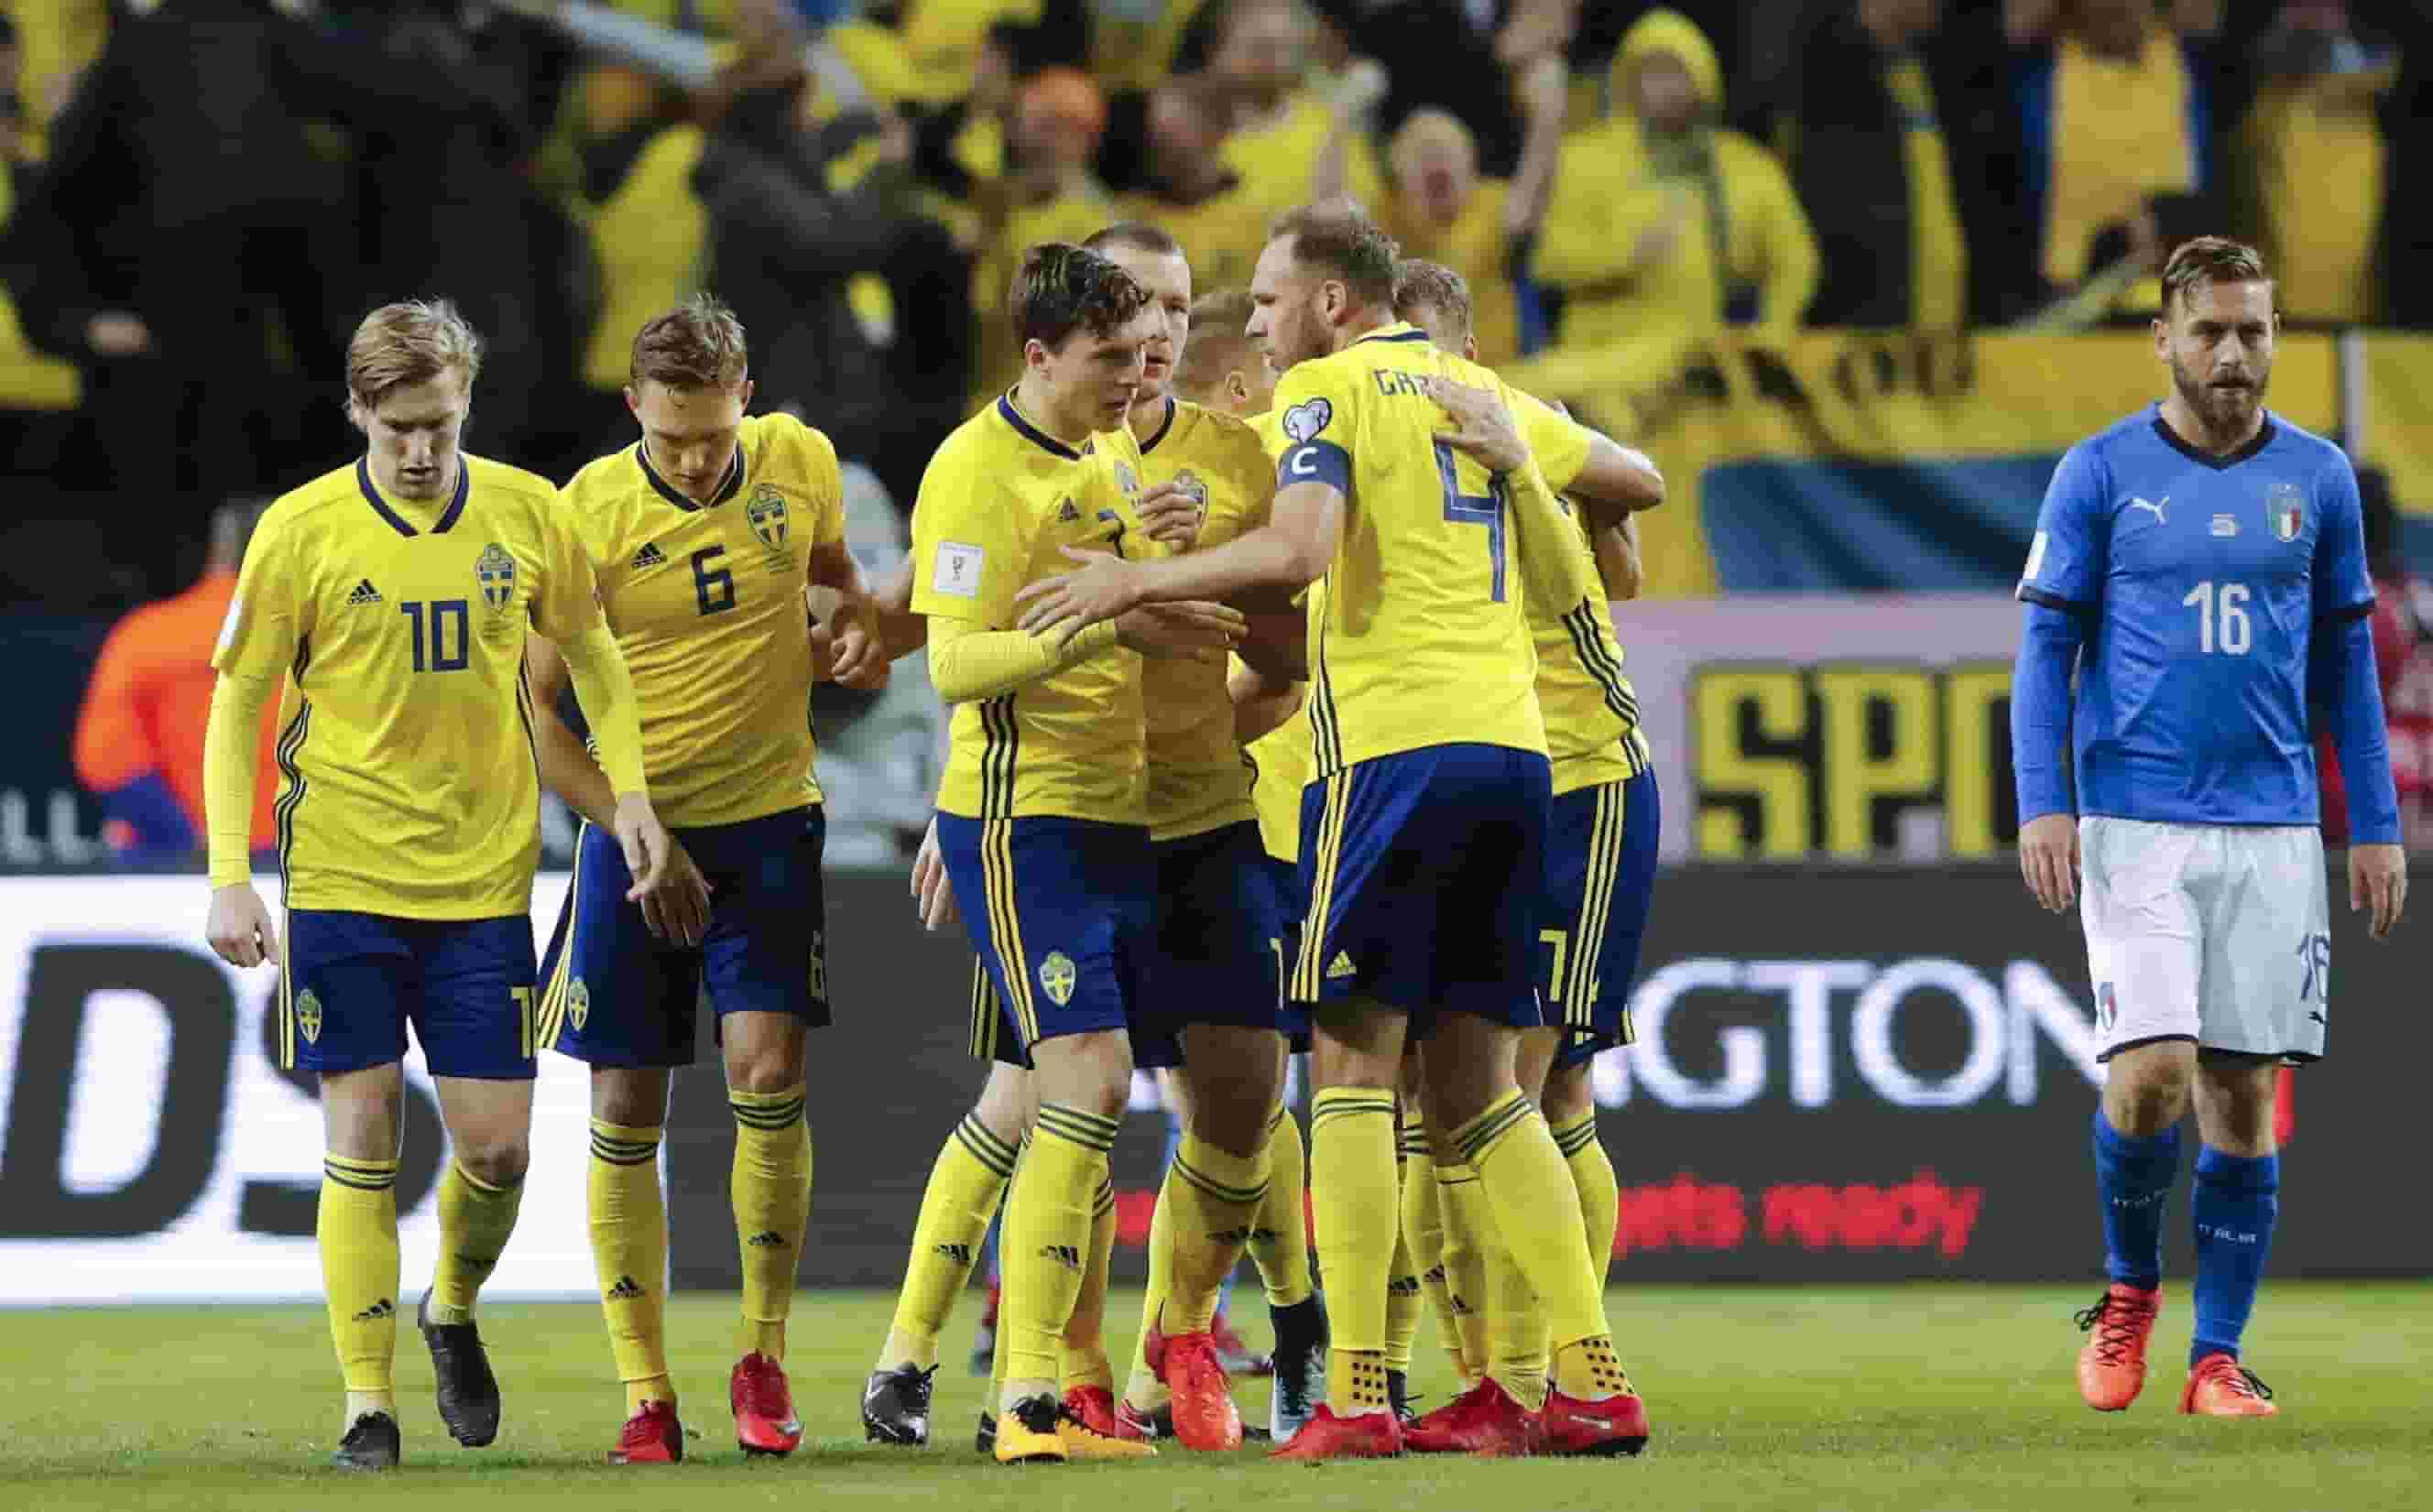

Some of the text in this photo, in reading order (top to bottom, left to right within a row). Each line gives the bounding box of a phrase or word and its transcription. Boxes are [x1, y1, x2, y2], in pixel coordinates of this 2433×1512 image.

[1290, 446, 1318, 474] C
[1432, 433, 1508, 601] 4
[692, 544, 736, 615] 6
[400, 599, 470, 672] 10
[2182, 580, 2251, 654] 16
[510, 985, 538, 1058] 1
[1762, 1170, 1980, 1258] ready
